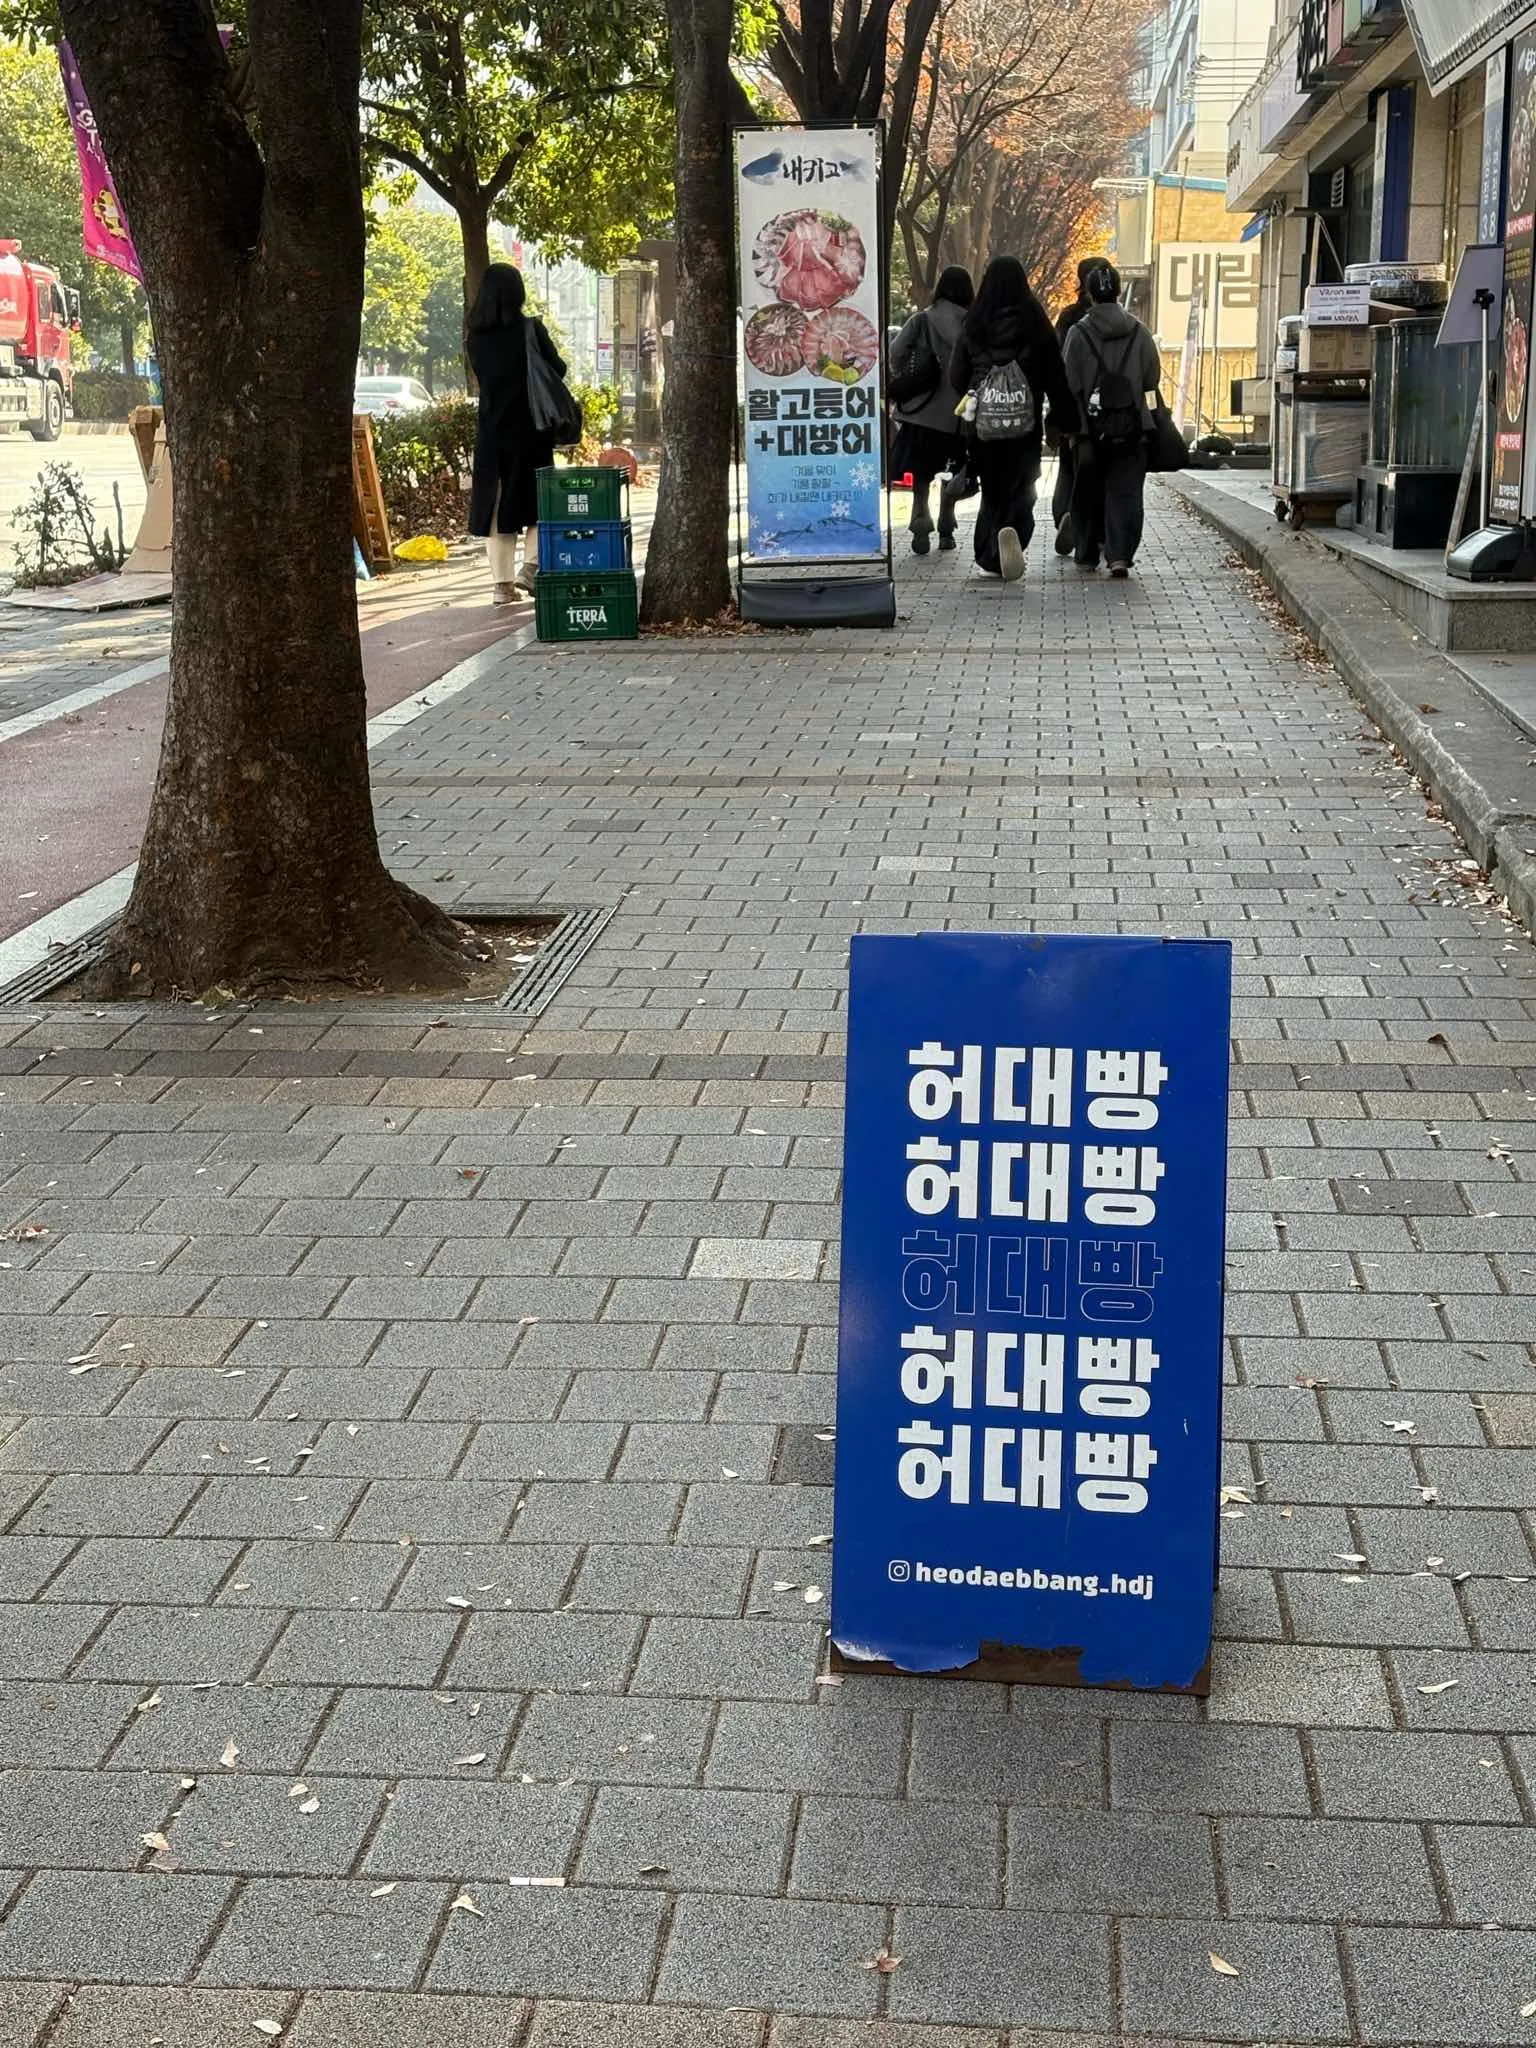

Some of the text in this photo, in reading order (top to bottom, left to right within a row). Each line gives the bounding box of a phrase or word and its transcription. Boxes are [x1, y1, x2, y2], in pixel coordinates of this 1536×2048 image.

[783, 155, 841, 186] 내키고
[1169, 253, 1260, 309] 대림
[748, 387, 875, 421] 활고등어
[754, 423, 872, 456] +대방어
[566, 606, 608, 624] TERRA
[907, 1042, 1167, 1129] 허대빵
[907, 1137, 1164, 1225] 허대빵
[902, 1230, 1163, 1322] 허대빵
[901, 1326, 1159, 1417] 허대빵
[899, 1420, 1157, 1513] 허대빵
[916, 1562, 1153, 1600] heodaebbang_hdj
